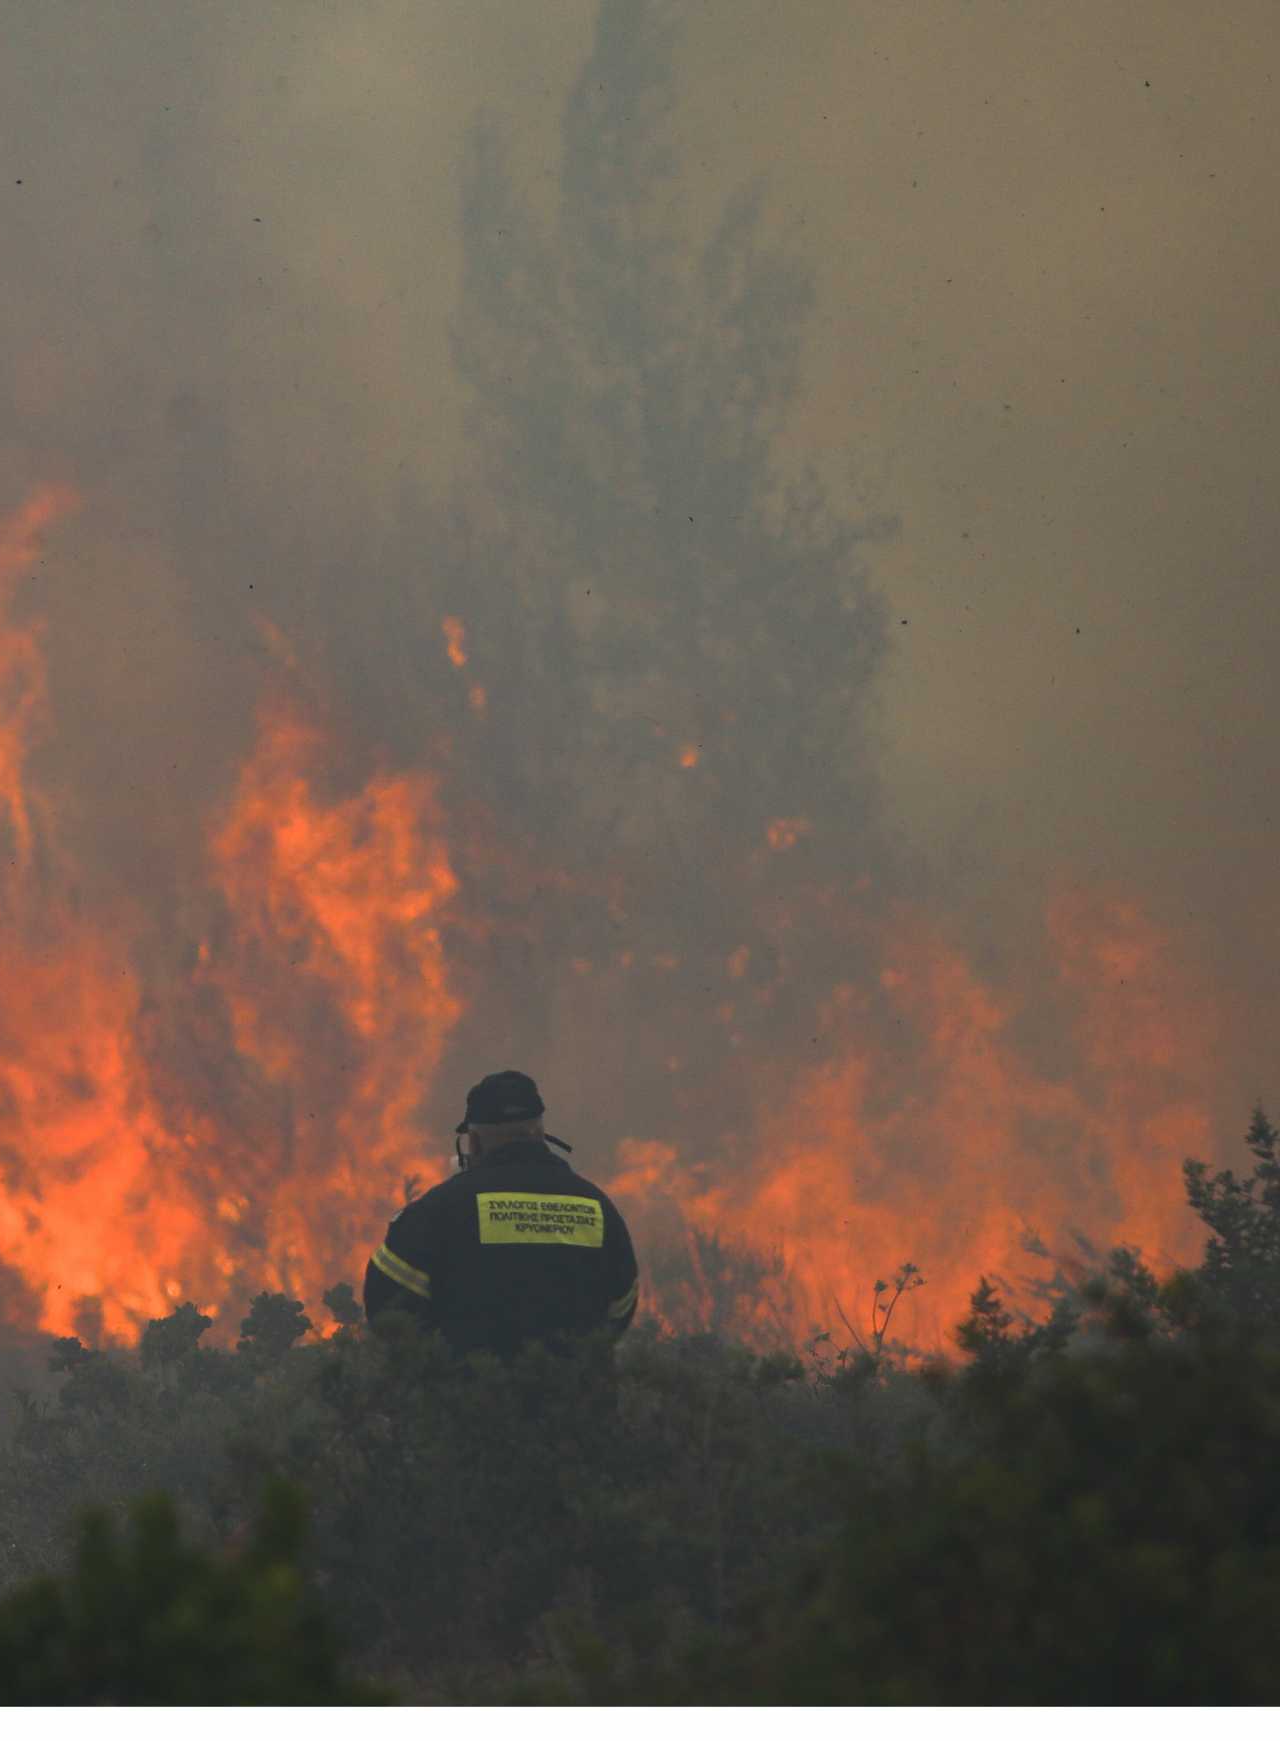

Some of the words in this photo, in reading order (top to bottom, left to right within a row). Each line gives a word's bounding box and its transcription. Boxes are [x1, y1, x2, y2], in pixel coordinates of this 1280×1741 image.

[488, 1200, 538, 1211] ΣΥΛΛΟΓΟΣ
[489, 1212, 538, 1222] ΠΟΛΙΤΙΚΗΣ
[540, 1213, 595, 1226] ΠΡΟΣΤΑΣΙΑΣ
